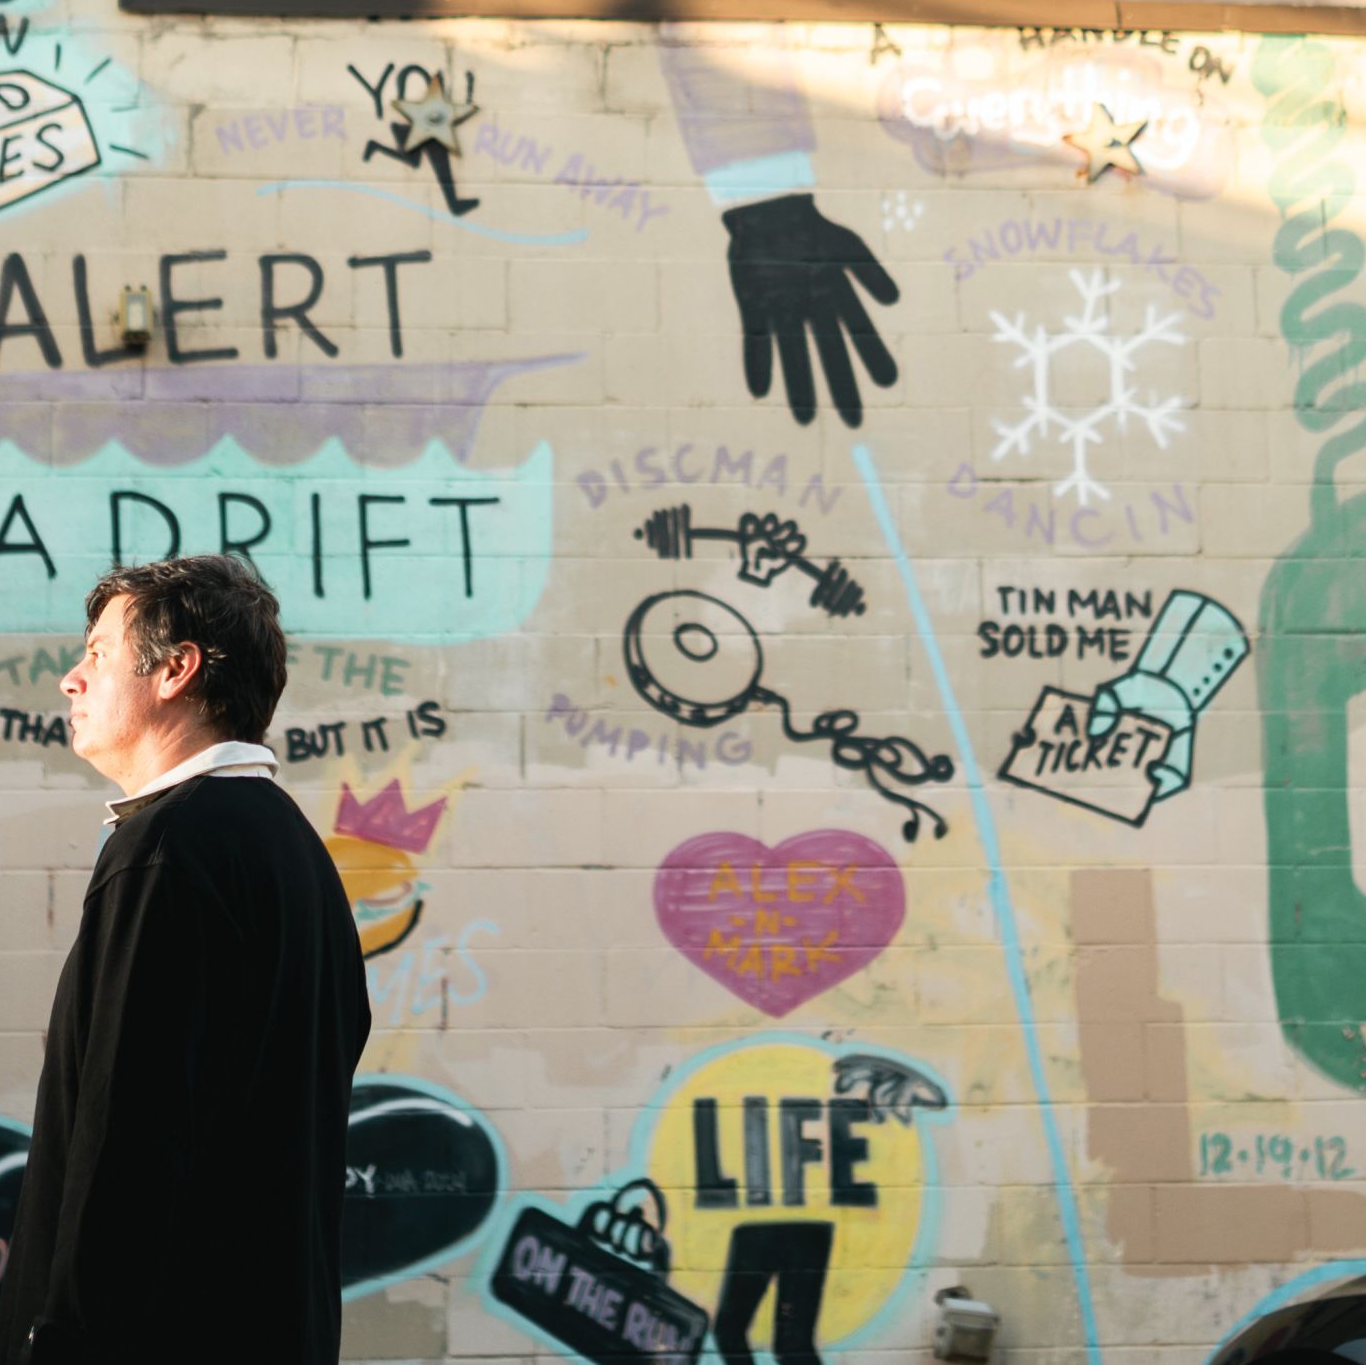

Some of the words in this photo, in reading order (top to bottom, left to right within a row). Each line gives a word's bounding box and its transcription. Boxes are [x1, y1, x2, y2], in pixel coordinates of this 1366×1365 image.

[1189, 45, 1233, 85] ON
[215, 105, 349, 157] NEVER
[472, 123, 546, 177] RUN
[553, 152, 671, 233] AWAY
[942, 217, 1223, 322] SNOWFLAKES
[576, 446, 844, 516] DISCMAN
[946, 461, 1197, 549] DANCIN
[997, 585, 1056, 616] TIN
[1067, 588, 1153, 622] MAN
[978, 619, 1069, 661] SOLD
[1076, 624, 1133, 662] ME
[312, 645, 413, 698] THE
[284, 720, 348, 764] BUT
[360, 716, 390, 753] IT
[406, 700, 448, 740] IS
[543, 693, 757, 771] PUMPING
[1053, 702, 1080, 737] A
[1035, 725, 1163, 777] TICKET
[708, 860, 868, 908] ALEX
[703, 929, 845, 982] MARK
[691, 1095, 880, 1211] LIFE
[511, 1235, 569, 1295] ON
[566, 1265, 625, 1332] THE
